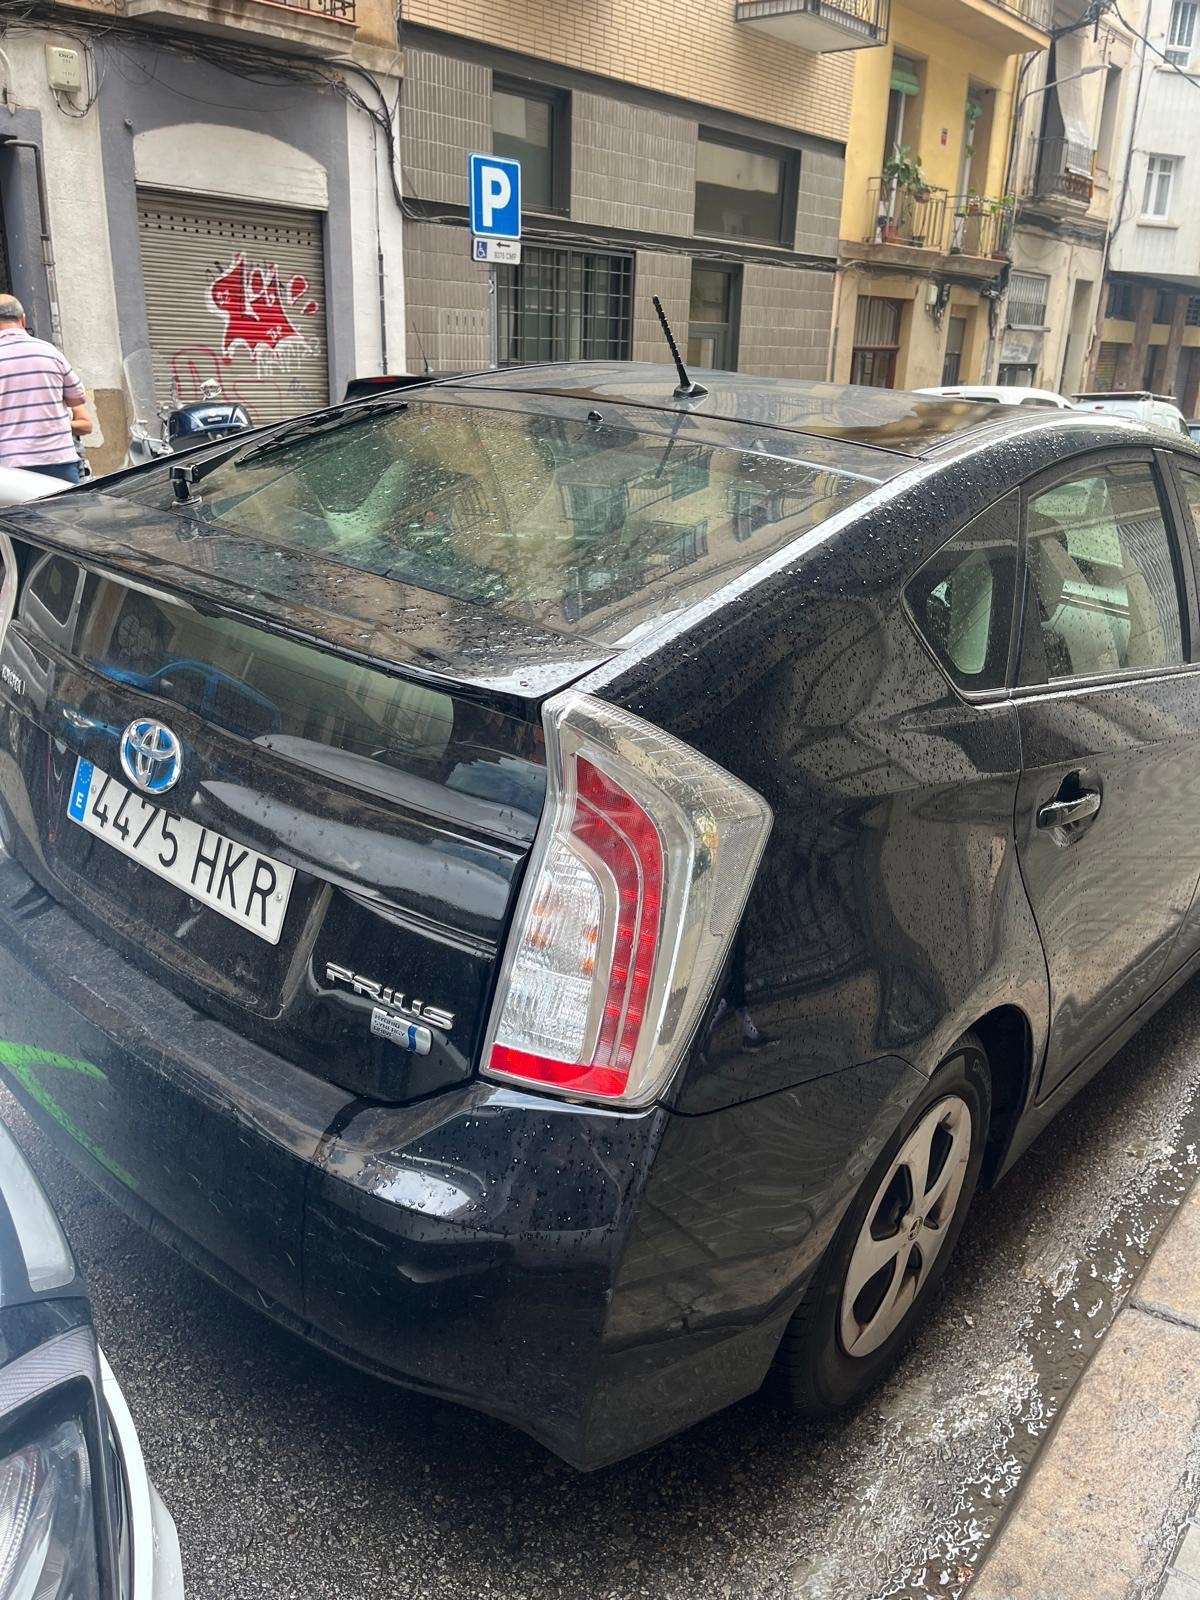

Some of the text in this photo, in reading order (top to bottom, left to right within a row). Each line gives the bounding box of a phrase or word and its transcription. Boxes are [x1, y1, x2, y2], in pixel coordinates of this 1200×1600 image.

[481, 166, 511, 227] P
[76, 791, 84, 809] E
[91, 775, 277, 927] 4475 HKR
[325, 961, 457, 1031] PRIUS
